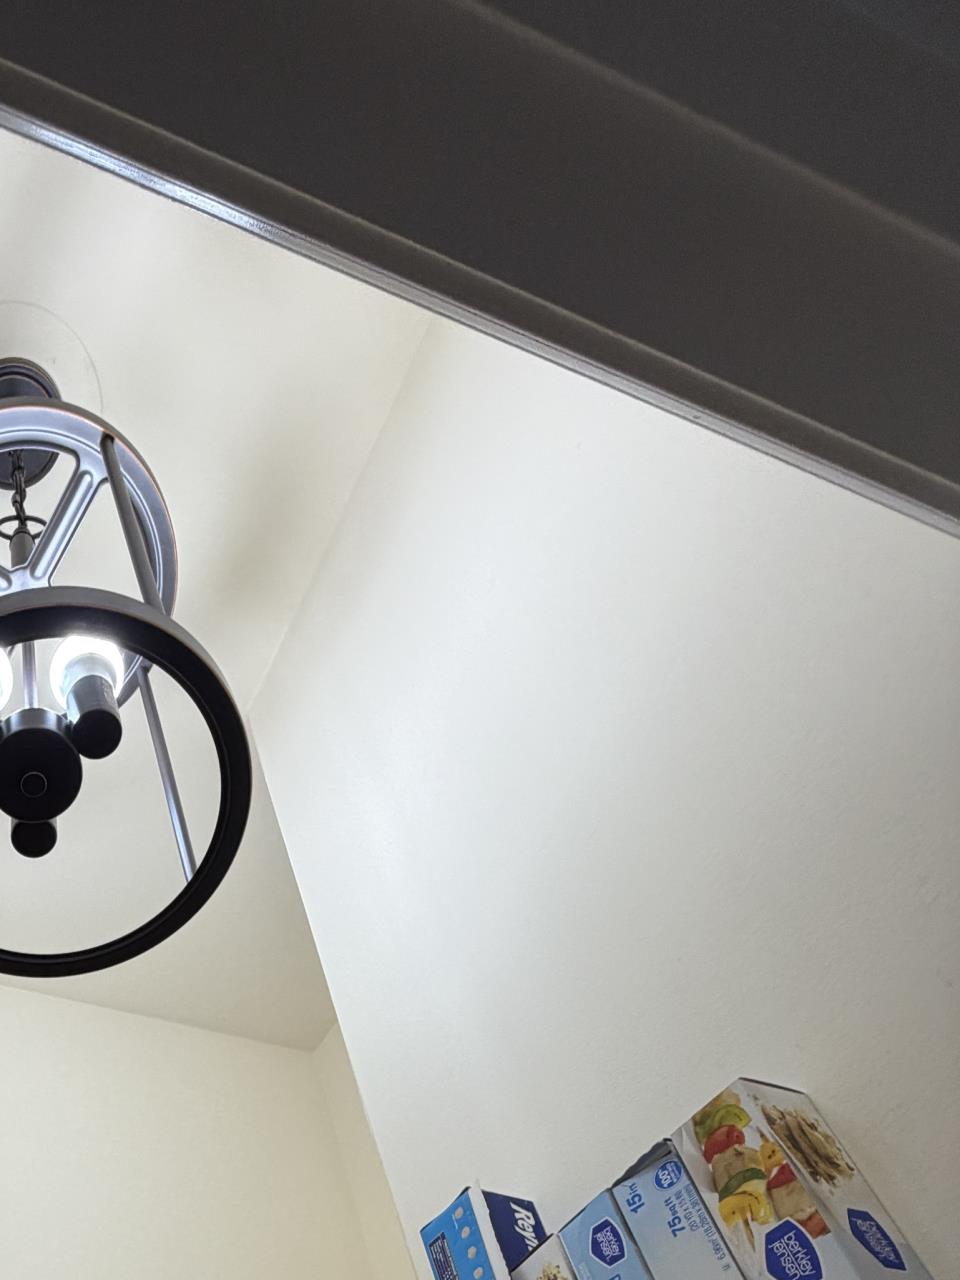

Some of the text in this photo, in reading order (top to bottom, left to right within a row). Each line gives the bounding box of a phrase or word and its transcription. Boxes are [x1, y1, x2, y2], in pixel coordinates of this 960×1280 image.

[510, 1201, 539, 1251] Reyn
[604, 1226, 620, 1256] berkley
[780, 1229, 818, 1278] berkley
